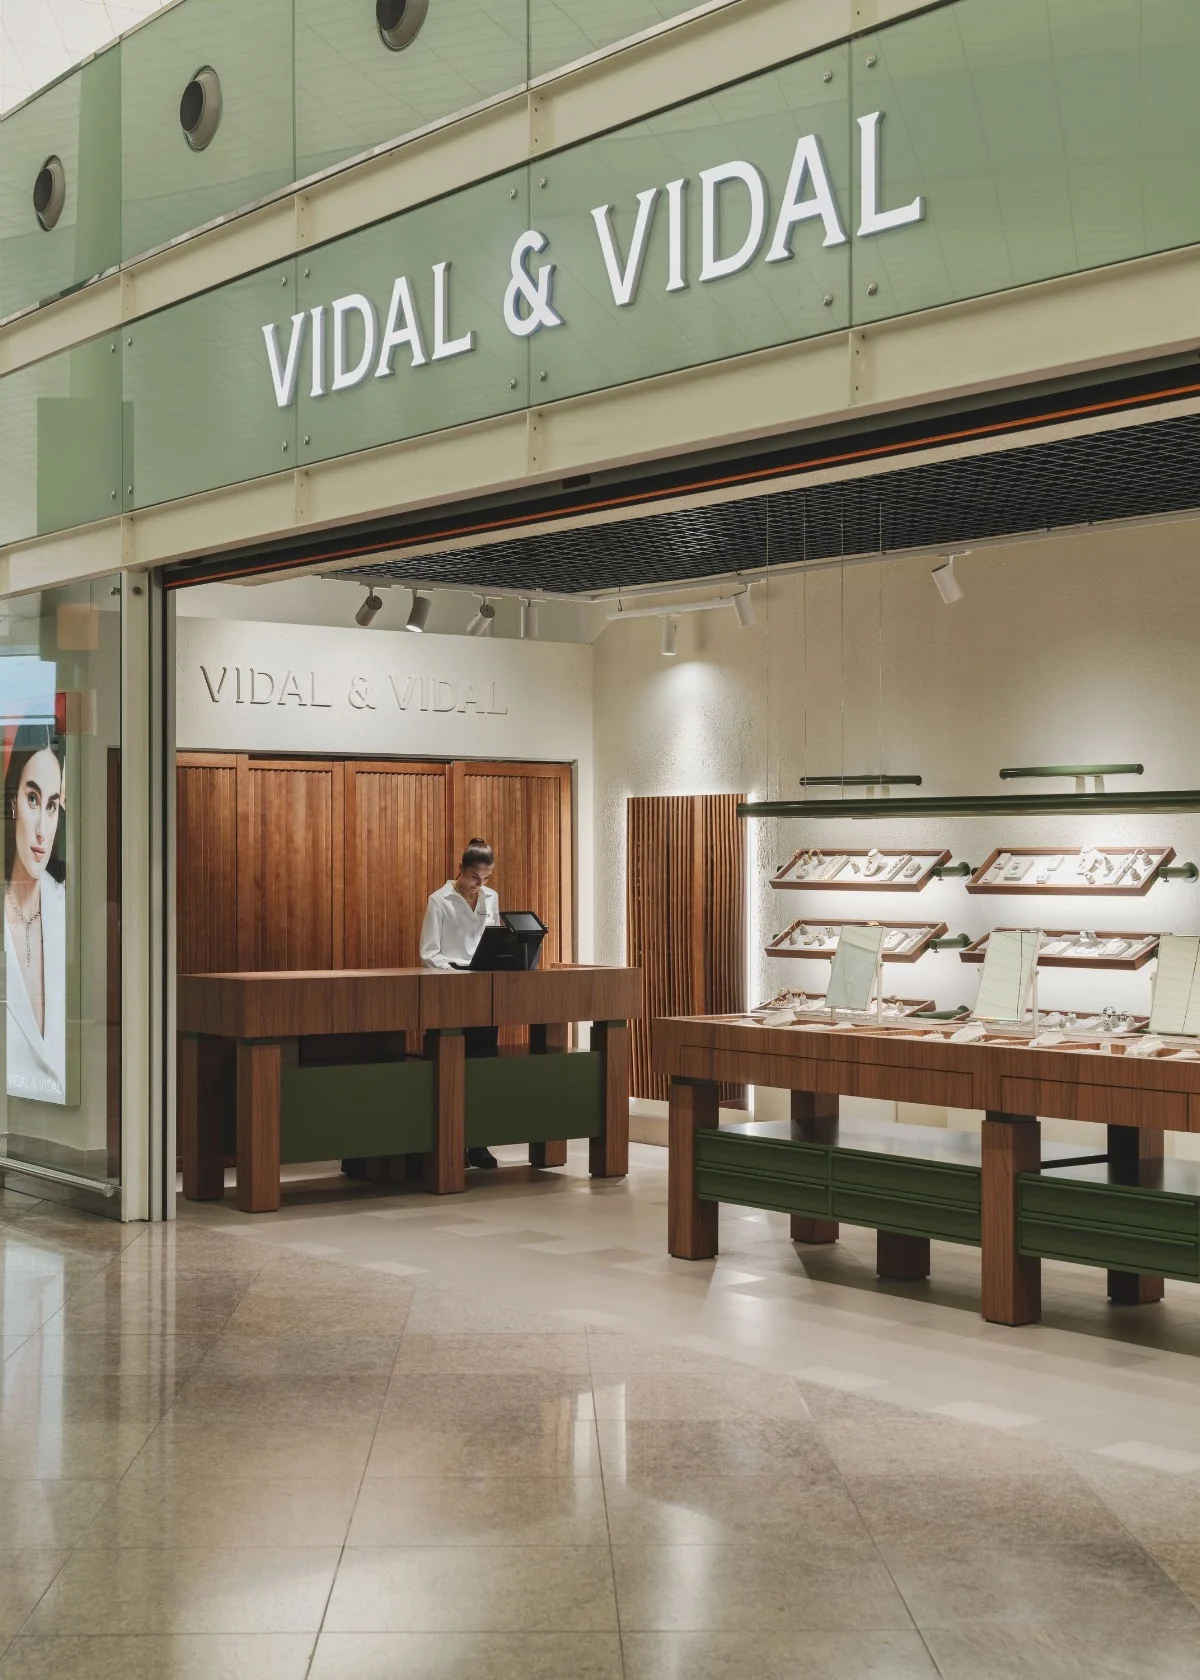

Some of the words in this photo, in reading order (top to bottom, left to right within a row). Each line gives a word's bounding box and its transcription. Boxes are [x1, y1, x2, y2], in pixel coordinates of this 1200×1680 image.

[261, 262, 476, 408] VIDAL
[503, 229, 566, 338] &
[590, 111, 925, 307] VIDAL
[200, 665, 332, 708] VIDAL
[348, 673, 376, 710] &
[388, 675, 508, 715] VIDAL
[8, 1073, 30, 1089] VIDAL
[39, 1078, 62, 1095] VIDAL
